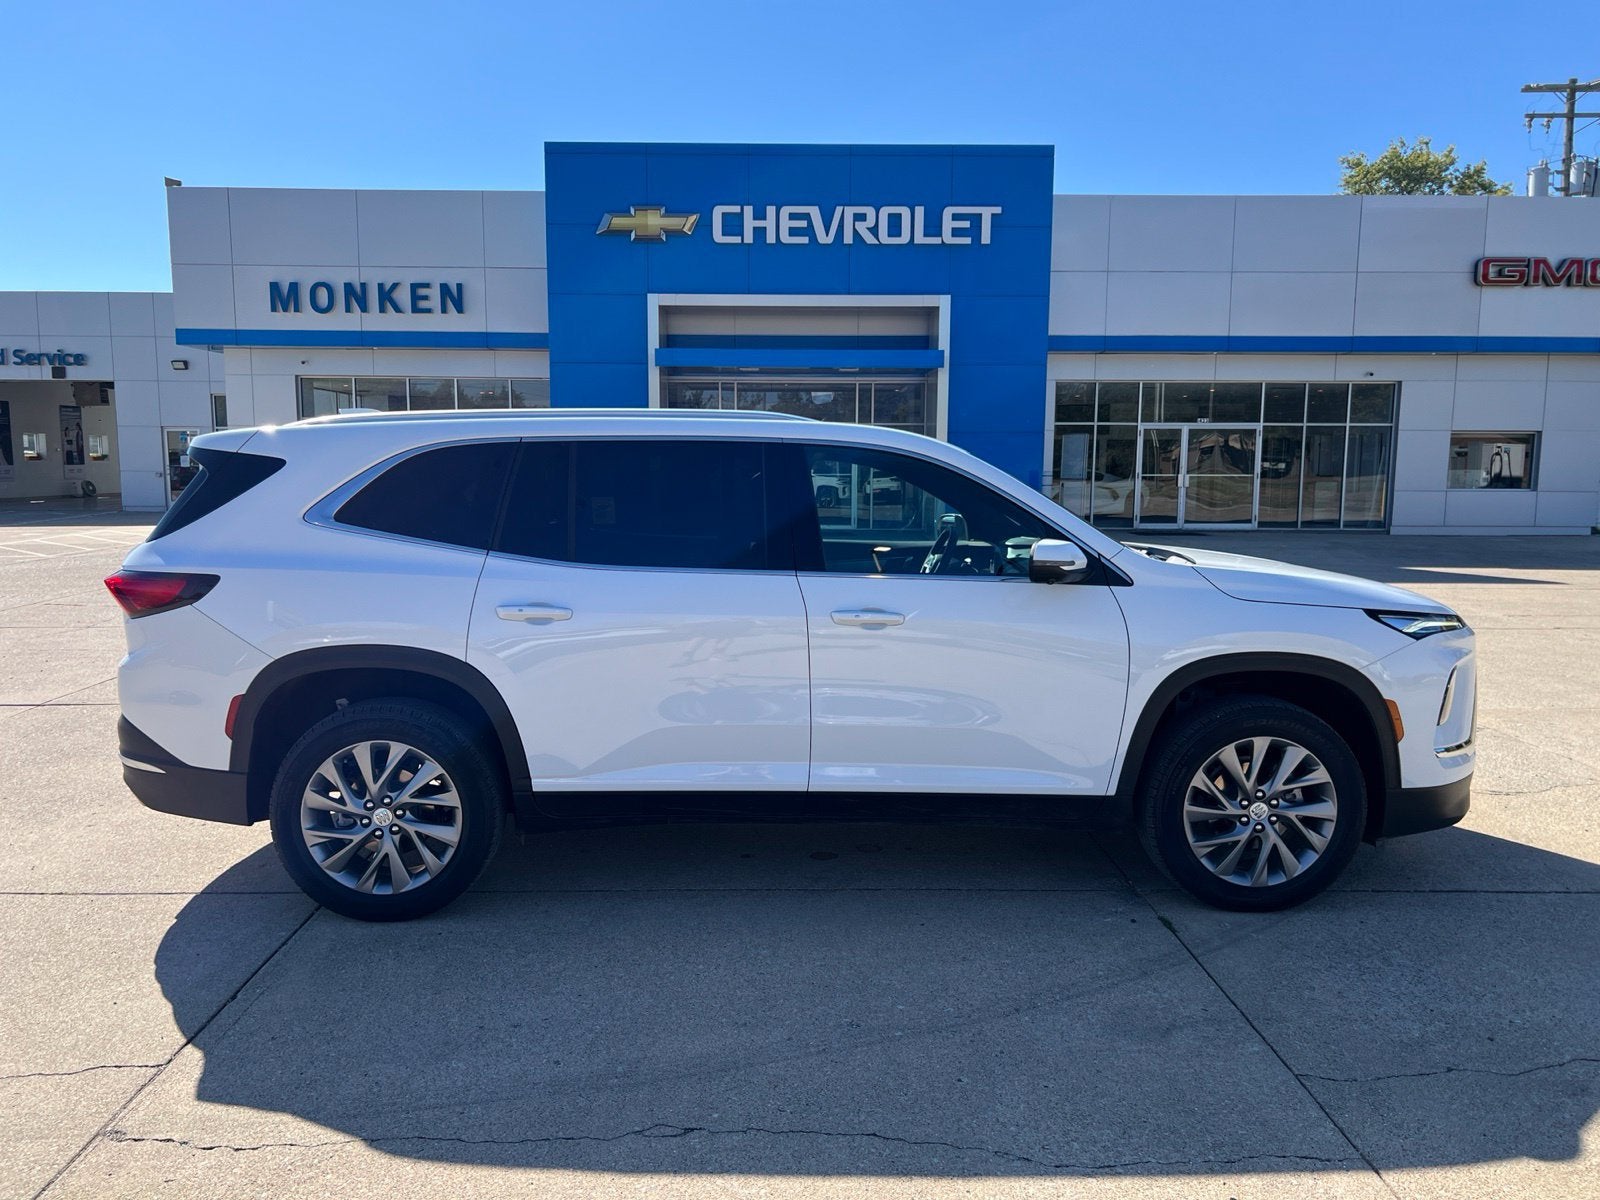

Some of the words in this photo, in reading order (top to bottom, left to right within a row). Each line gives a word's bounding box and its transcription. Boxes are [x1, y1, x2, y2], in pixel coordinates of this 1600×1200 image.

[712, 205, 1002, 245] CHEVROLET
[1474, 256, 1600, 287] GM
[269, 281, 465, 315] MONKEN
[12, 349, 87, 366] Service
